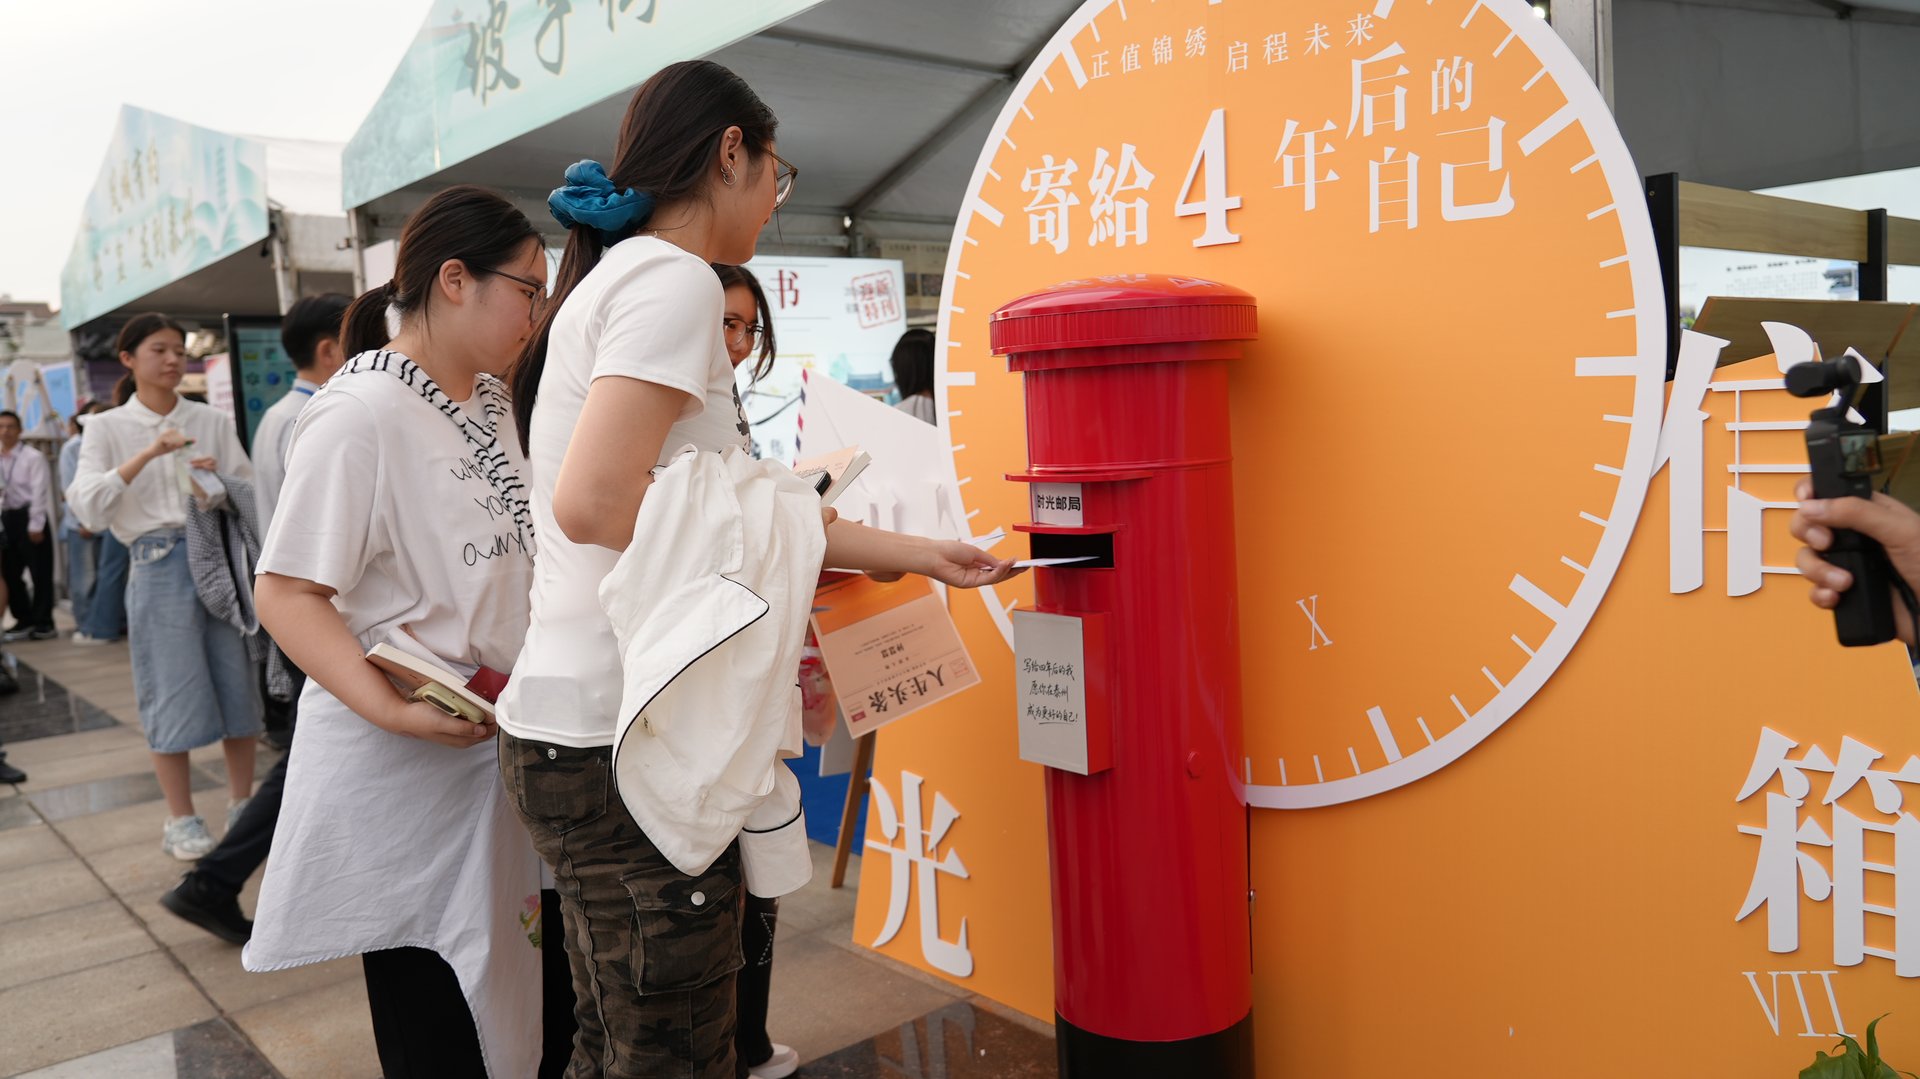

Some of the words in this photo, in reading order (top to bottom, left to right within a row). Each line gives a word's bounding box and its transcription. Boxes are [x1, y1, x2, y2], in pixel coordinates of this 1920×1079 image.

[1090, 25, 1208, 80] 正值锦绣
[1225, 12, 1375, 75] 启程未来
[769, 269, 800, 310] 书
[1037, 494, 1081, 512] 时光邮局
[1295, 594, 1334, 651] X
[868, 663, 945, 713] 人生头条
[1023, 658, 1075, 681] 写给四年后的我
[1029, 680, 1069, 703] 愿你在泰州
[864, 769, 974, 978] 光
[1734, 726, 1920, 978] 箱
[1741, 969, 1857, 1038] VII
